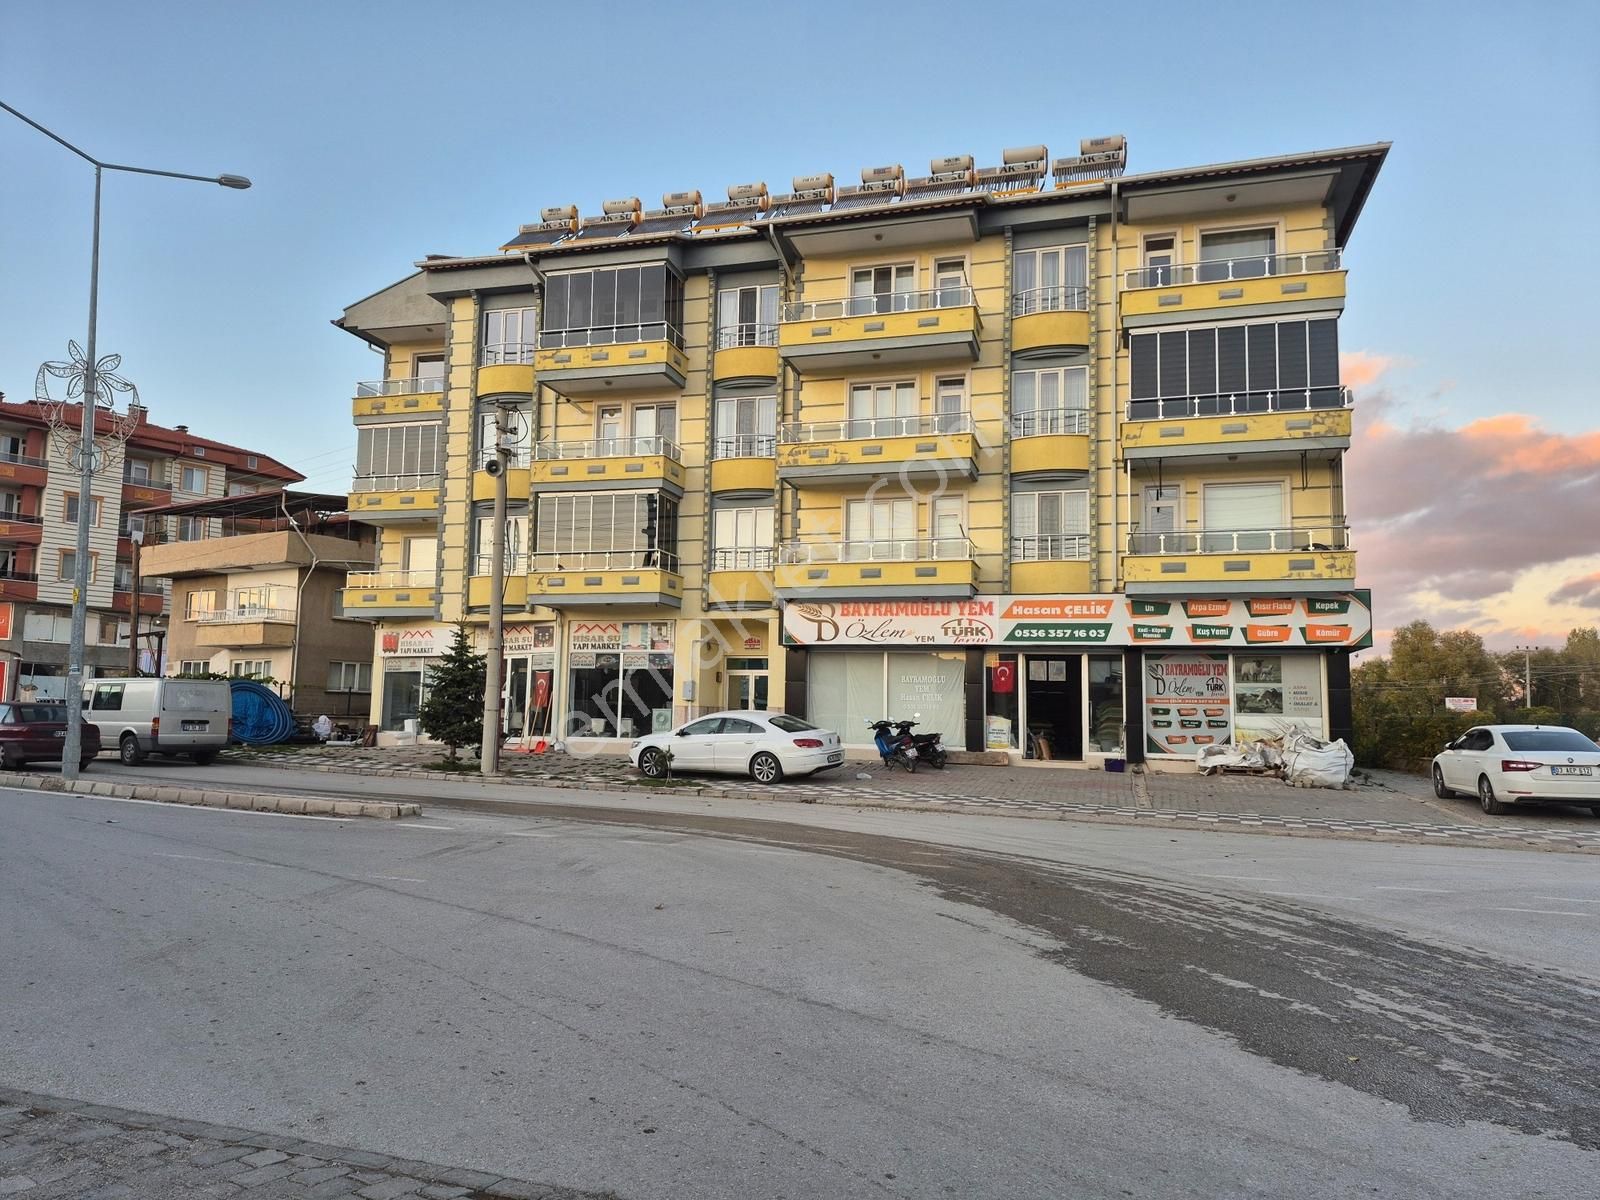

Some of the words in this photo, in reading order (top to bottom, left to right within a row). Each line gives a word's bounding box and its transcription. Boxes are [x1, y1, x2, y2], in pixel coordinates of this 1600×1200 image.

[953, 601, 994, 616] YEM
[1012, 605, 1061, 615] Hasan
[1064, 602, 1107, 617] ÇELİK
[1190, 604, 1207, 613] Arpa
[1272, 602, 1292, 610] Flake
[1315, 602, 1339, 610] Kepek
[845, 619, 905, 643] Özlem
[941, 627, 986, 636] TÜRK
[1015, 629, 1046, 638] 0536
[1048, 629, 1072, 638] 357
[1073, 629, 1087, 638] 16
[1088, 629, 1105, 638] 03
[1196, 628, 1210, 636] Kuş
[1211, 628, 1229, 636] Yemi
[1315, 629, 1341, 637] Kömür
[606, 634, 621, 642] SU
[1165, 661, 1211, 676] BAYRAMOĞLU
[1211, 664, 1228, 676] YEM
